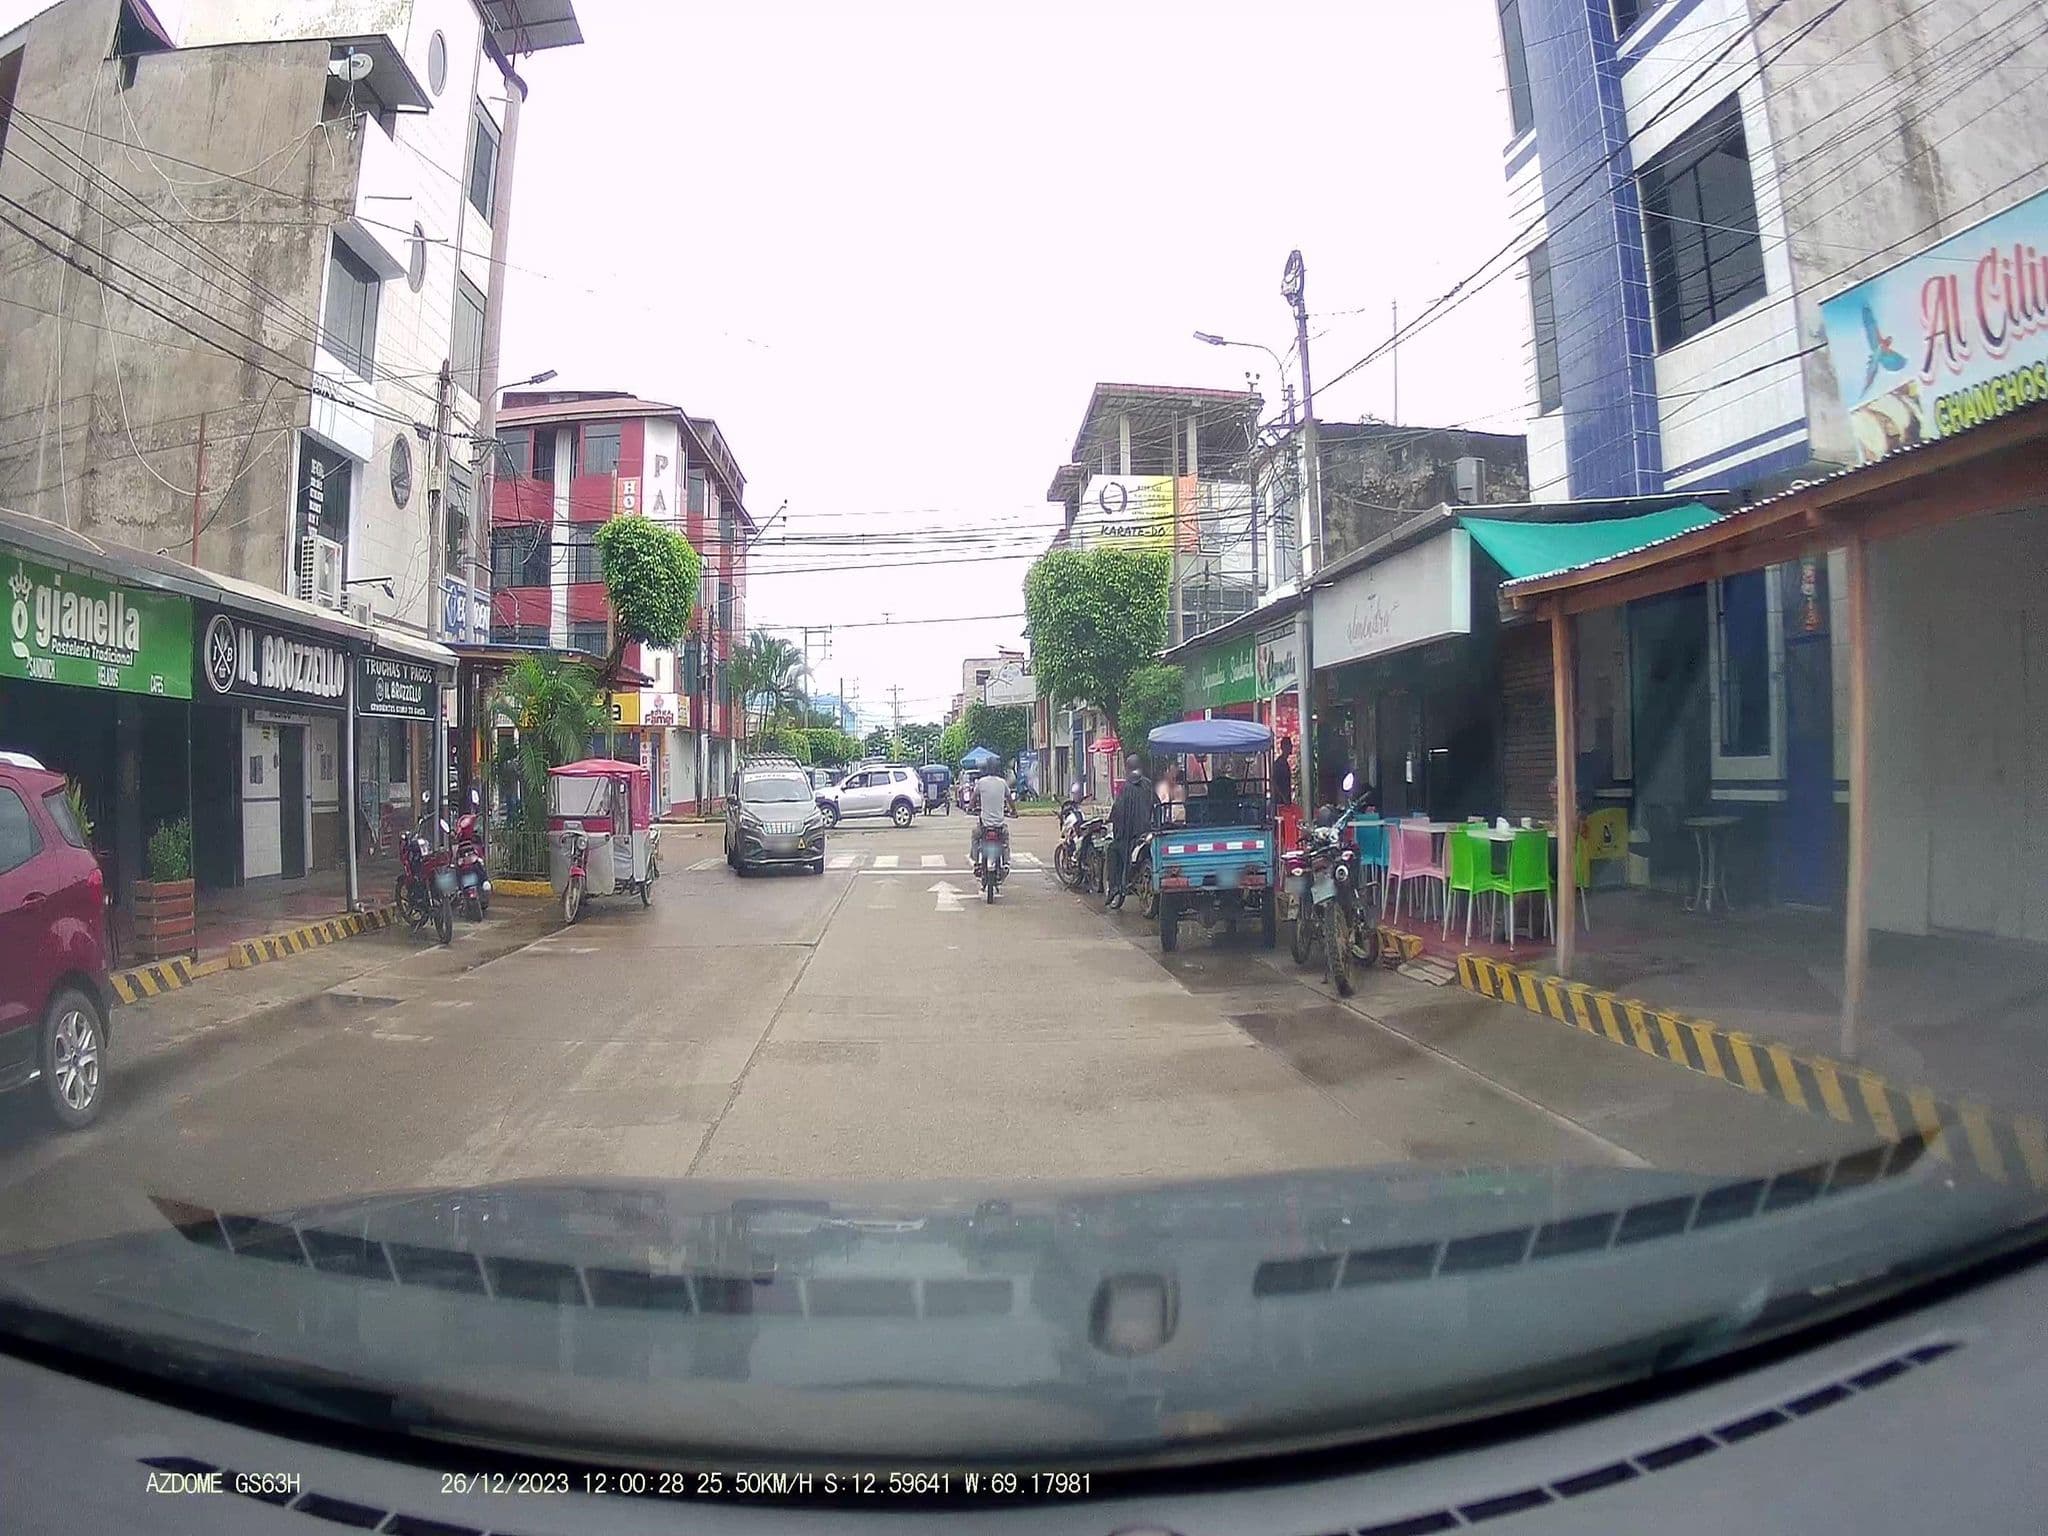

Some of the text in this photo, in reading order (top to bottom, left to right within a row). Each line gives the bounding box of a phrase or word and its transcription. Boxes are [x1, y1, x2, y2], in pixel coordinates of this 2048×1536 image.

[1921, 273, 1967, 376] Al
[1100, 525, 1166, 537] KARATE-DO
[36, 575, 140, 651] gianella
[92, 645, 133, 665] Tradicional
[239, 628, 345, 698] IL BROZZELLO
[365, 659, 401, 678] TRUCHAS
[402, 665, 409, 679] Y
